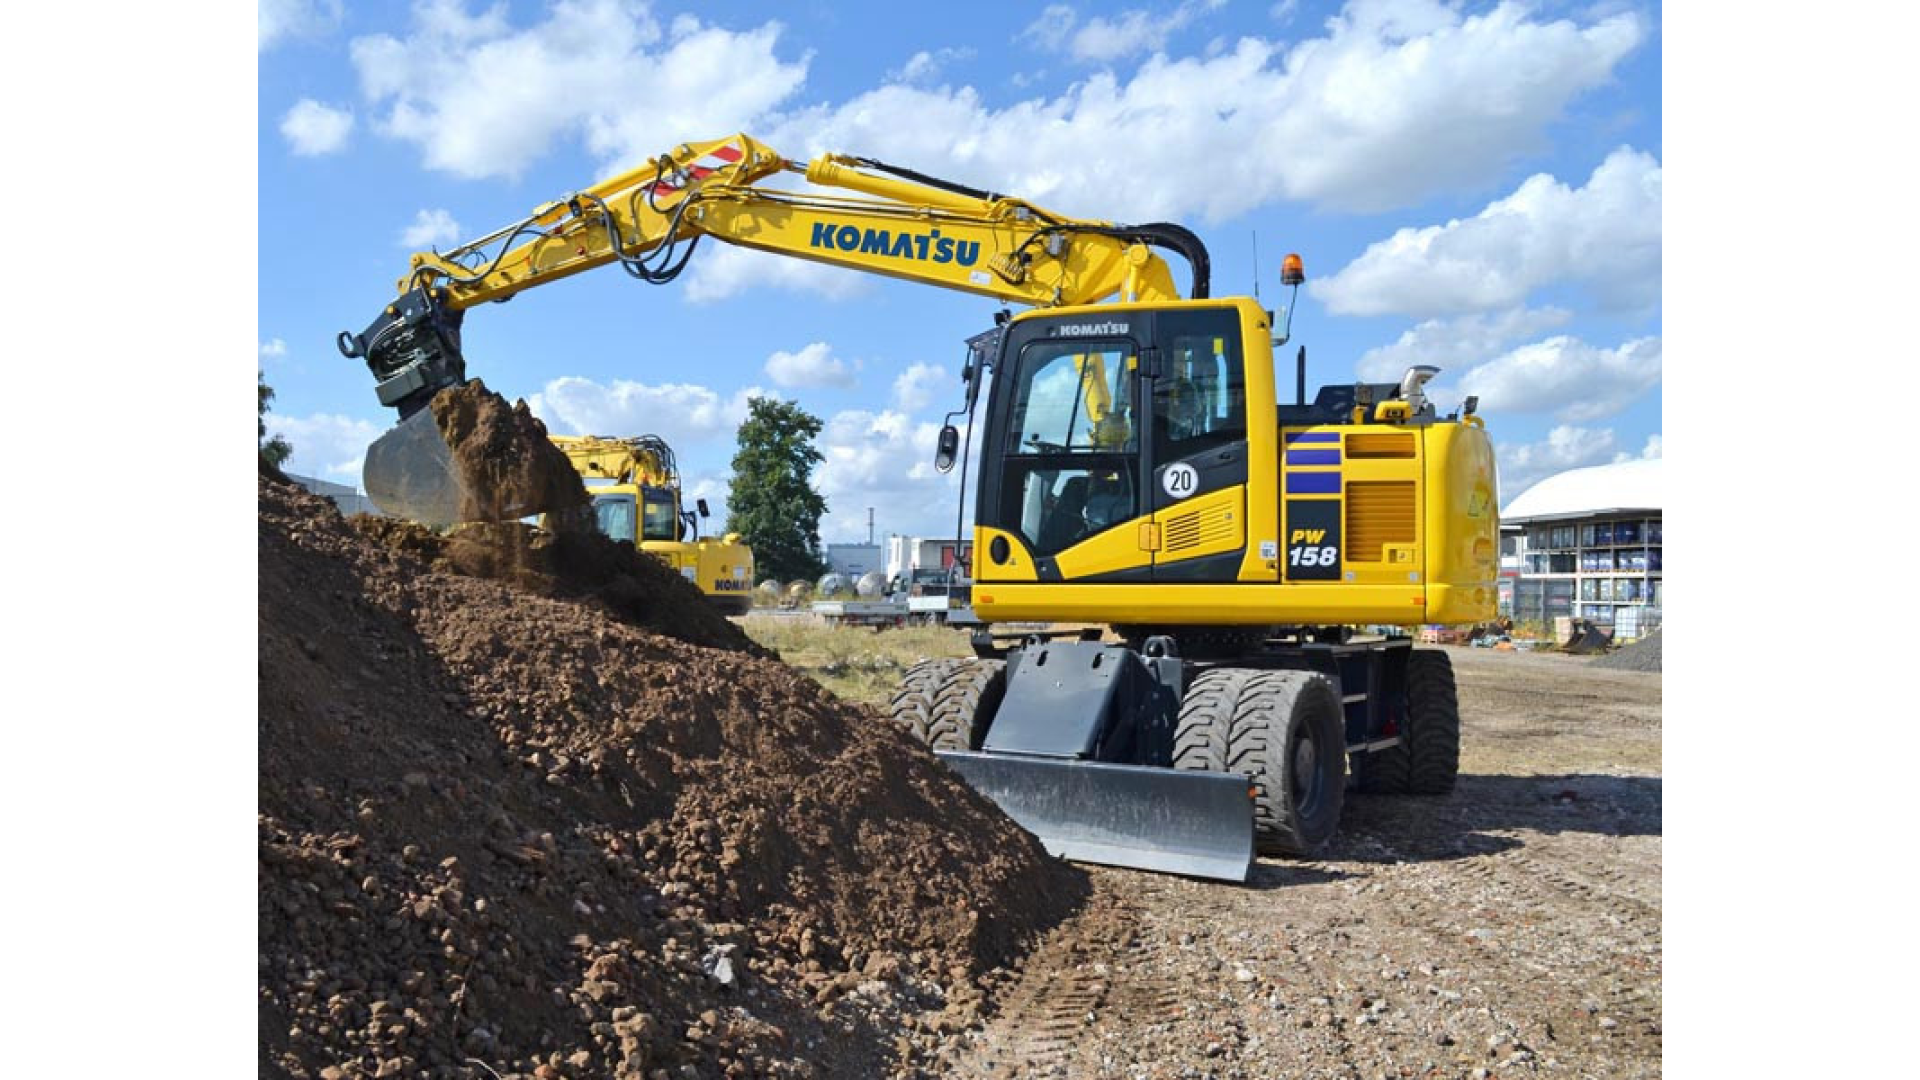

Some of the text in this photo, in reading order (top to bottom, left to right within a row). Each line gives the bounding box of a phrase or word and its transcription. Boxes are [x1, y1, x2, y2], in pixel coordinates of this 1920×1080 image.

[810, 222, 981, 267] KOMATSU
[1060, 320, 1130, 336] KOMATSU
[1170, 470, 1191, 491] 20
[1291, 529, 1326, 545] PW
[1290, 546, 1337, 567] 158
